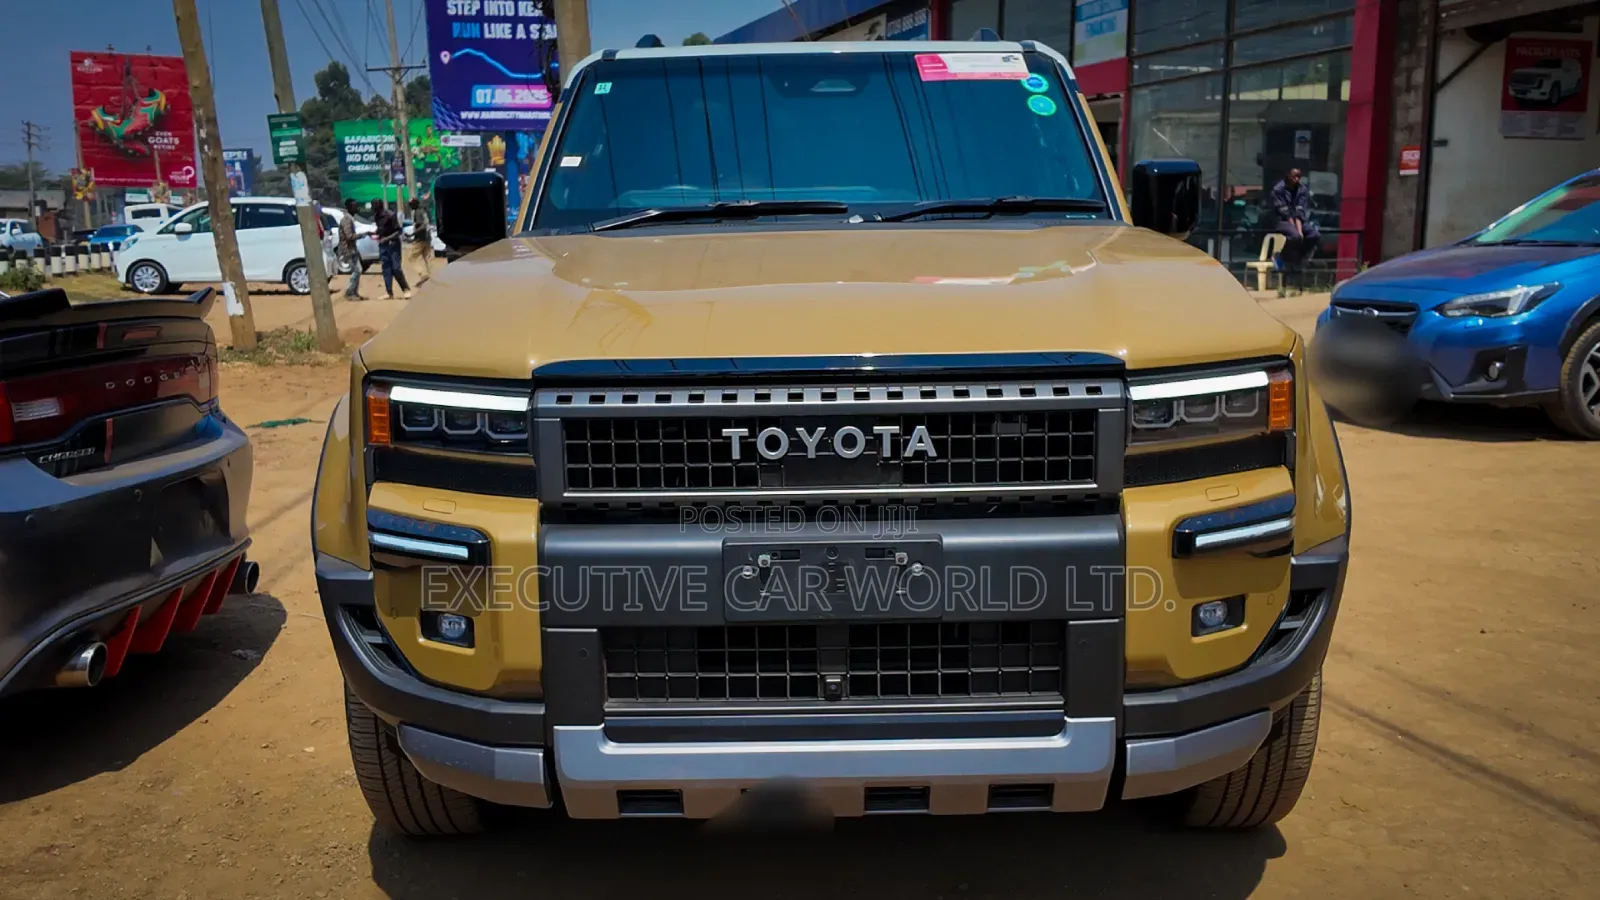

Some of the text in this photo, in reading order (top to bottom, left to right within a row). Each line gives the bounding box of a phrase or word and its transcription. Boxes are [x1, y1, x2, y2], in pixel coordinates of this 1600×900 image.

[447, 0, 480, 16] STEP
[483, 0, 515, 17] INTO
[452, 22, 480, 38] RUN
[484, 23, 512, 39] LIKE
[516, 23, 527, 39] A
[148, 136, 180, 146] GOATS
[345, 144, 375, 154] CHAPA
[346, 153, 361, 163] IKO
[105, 371, 181, 390] DODGE
[721, 425, 938, 460] TOYOTA
